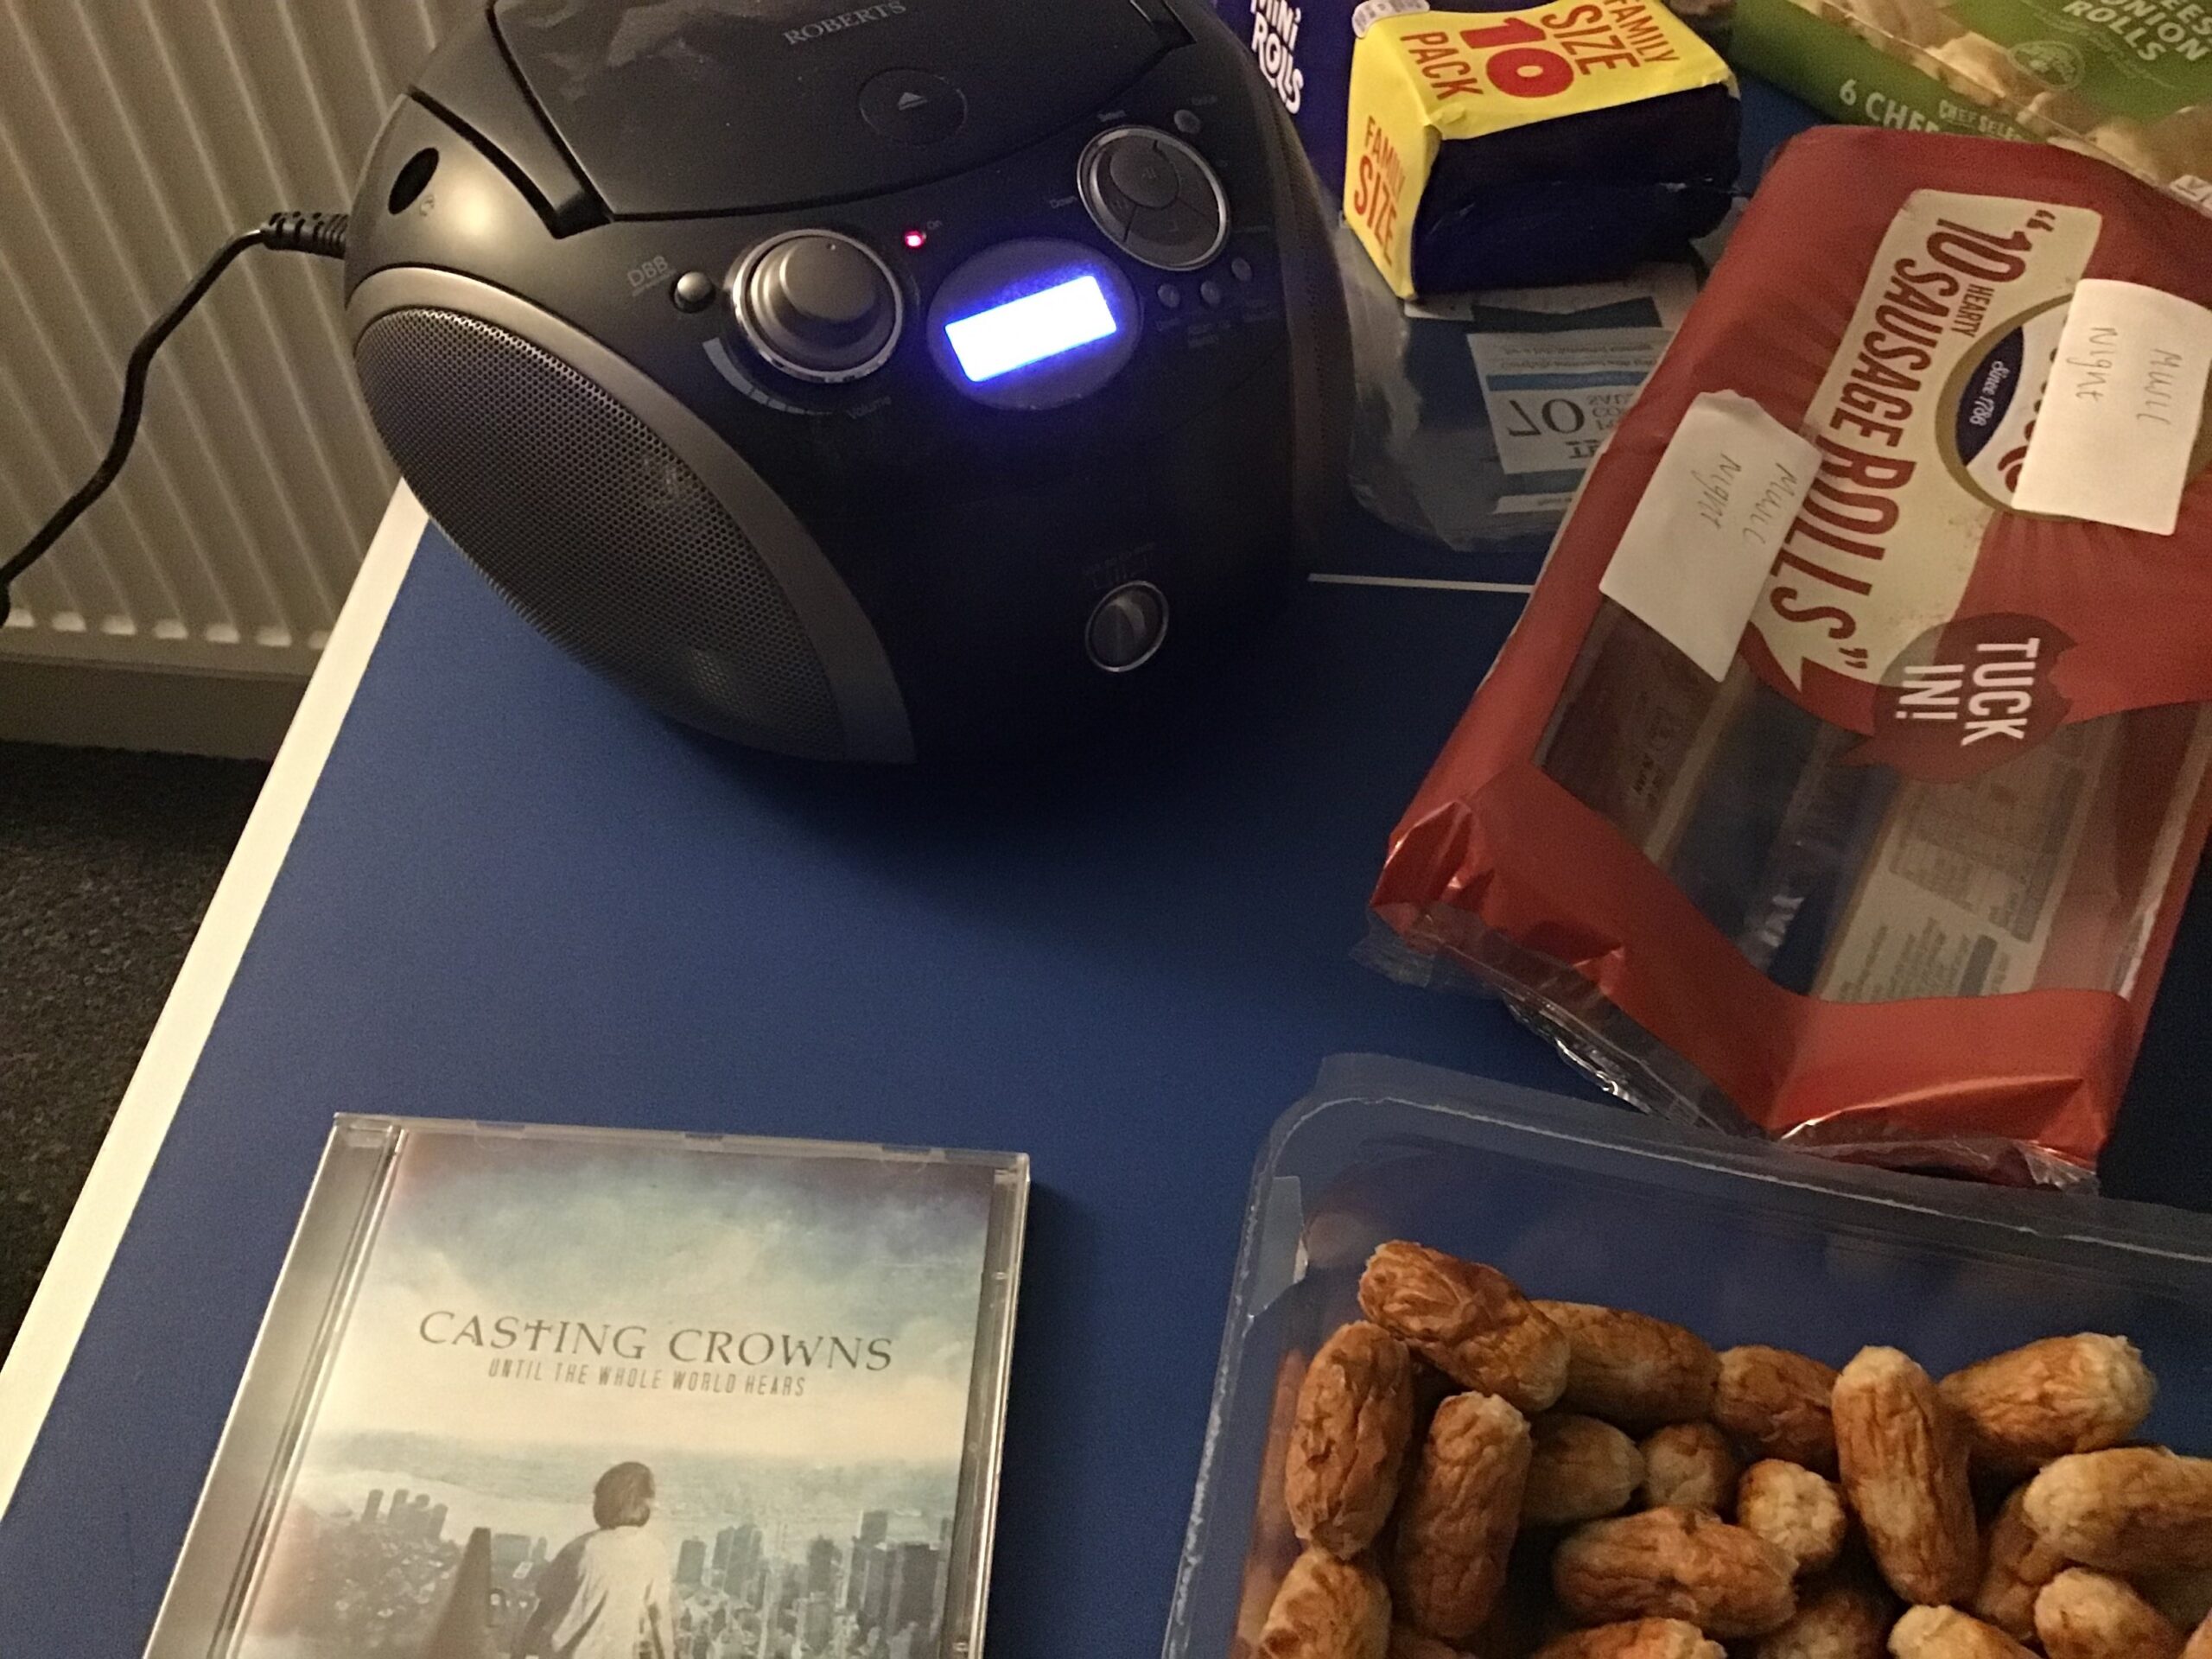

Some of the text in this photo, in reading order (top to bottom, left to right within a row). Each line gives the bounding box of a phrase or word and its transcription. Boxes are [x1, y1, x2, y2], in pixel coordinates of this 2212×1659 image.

[782, 1, 906, 44] ROBERTS
[1541, 3, 1640, 76] SIZE
[2062, 0, 2167, 61] ROLLS
[1251, 11, 1305, 115] ROLLS
[1399, 31, 1484, 101] PACK
[1460, 16, 1575, 99] 10
[1839, 79, 1858, 106] 6
[1363, 114, 1406, 205] FAMILY
[1353, 154, 1398, 267] SIZE
[626, 255, 670, 289] DBB
[1951, 283, 1996, 339] HEARTY
[1827, 257, 1961, 448] SAUSAGE
[1981, 359, 2011, 396] Since
[845, 395, 893, 419] Volume
[1895, 663, 1965, 721] IN!
[1960, 637, 2041, 747] TUCK
[419, 1310, 893, 1372] CASTING CROWNS
[487, 1357, 806, 1397] UNTIL THE WHOLE WORLD HEARS
